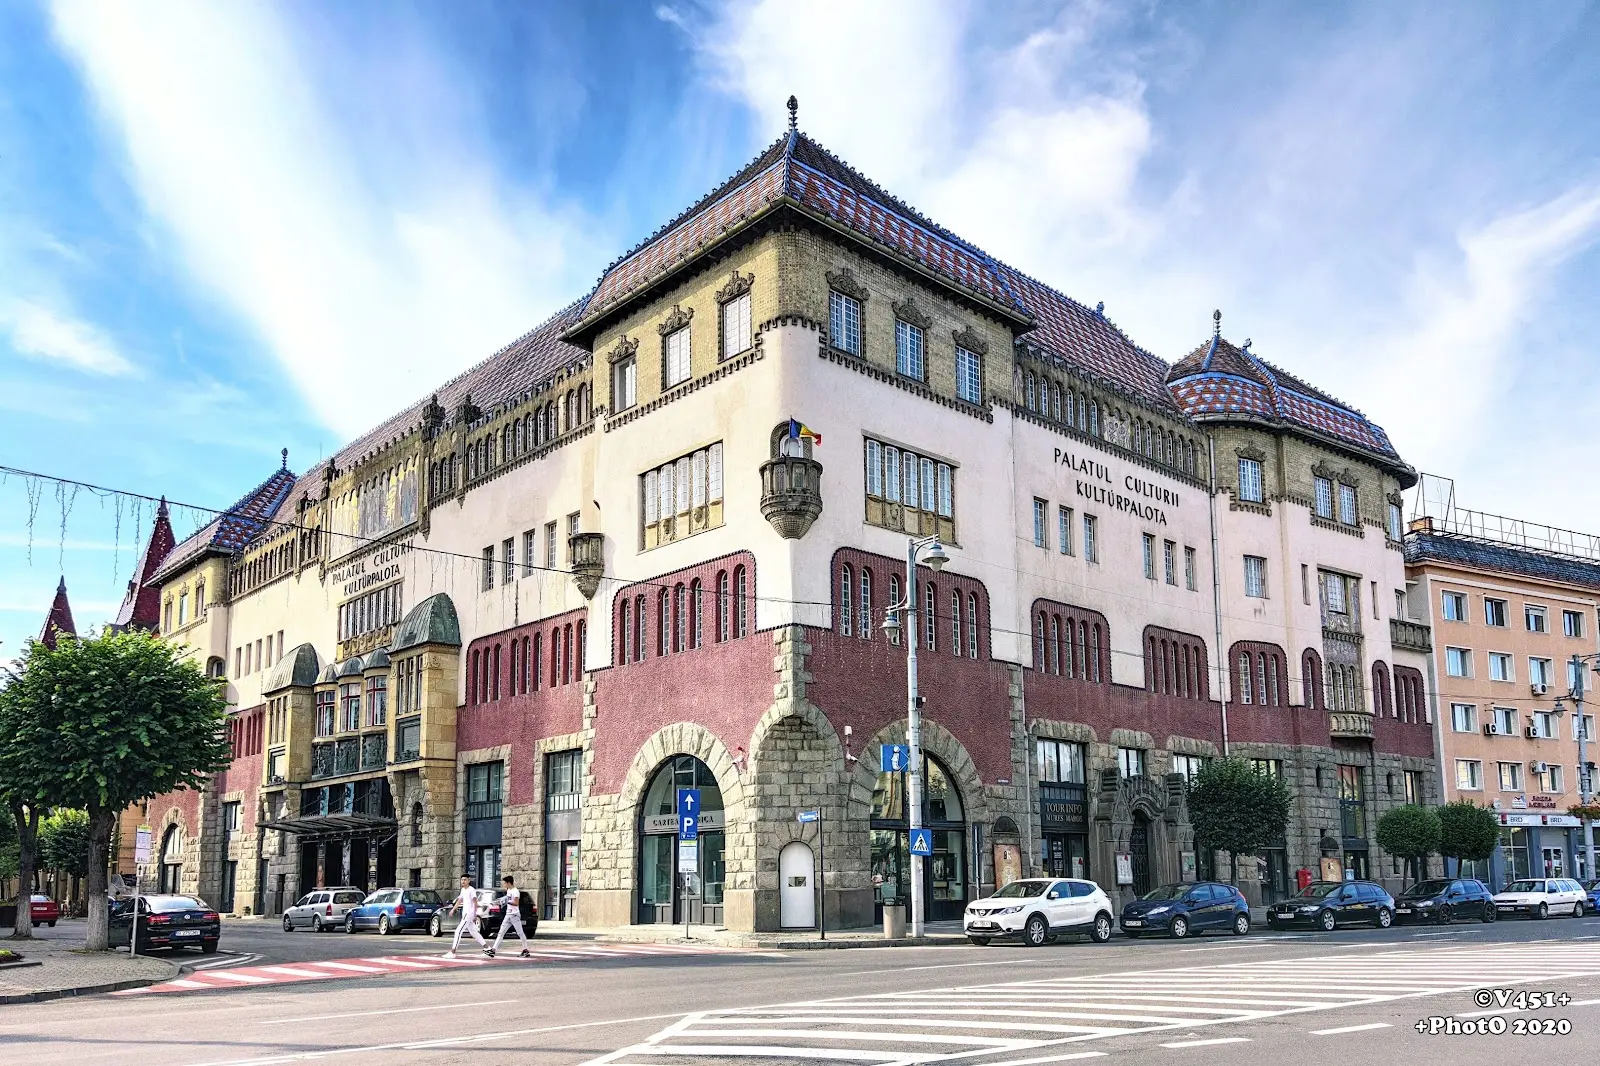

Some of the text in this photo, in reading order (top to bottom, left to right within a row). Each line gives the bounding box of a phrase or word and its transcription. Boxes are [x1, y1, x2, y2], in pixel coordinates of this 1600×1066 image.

[1054, 447, 1179, 507] PALATUL CULTURII
[1076, 480, 1167, 526] KULTÚRPALOTA
[332, 539, 413, 585] PALATUL CULTURII
[683, 817, 694, 833] P
